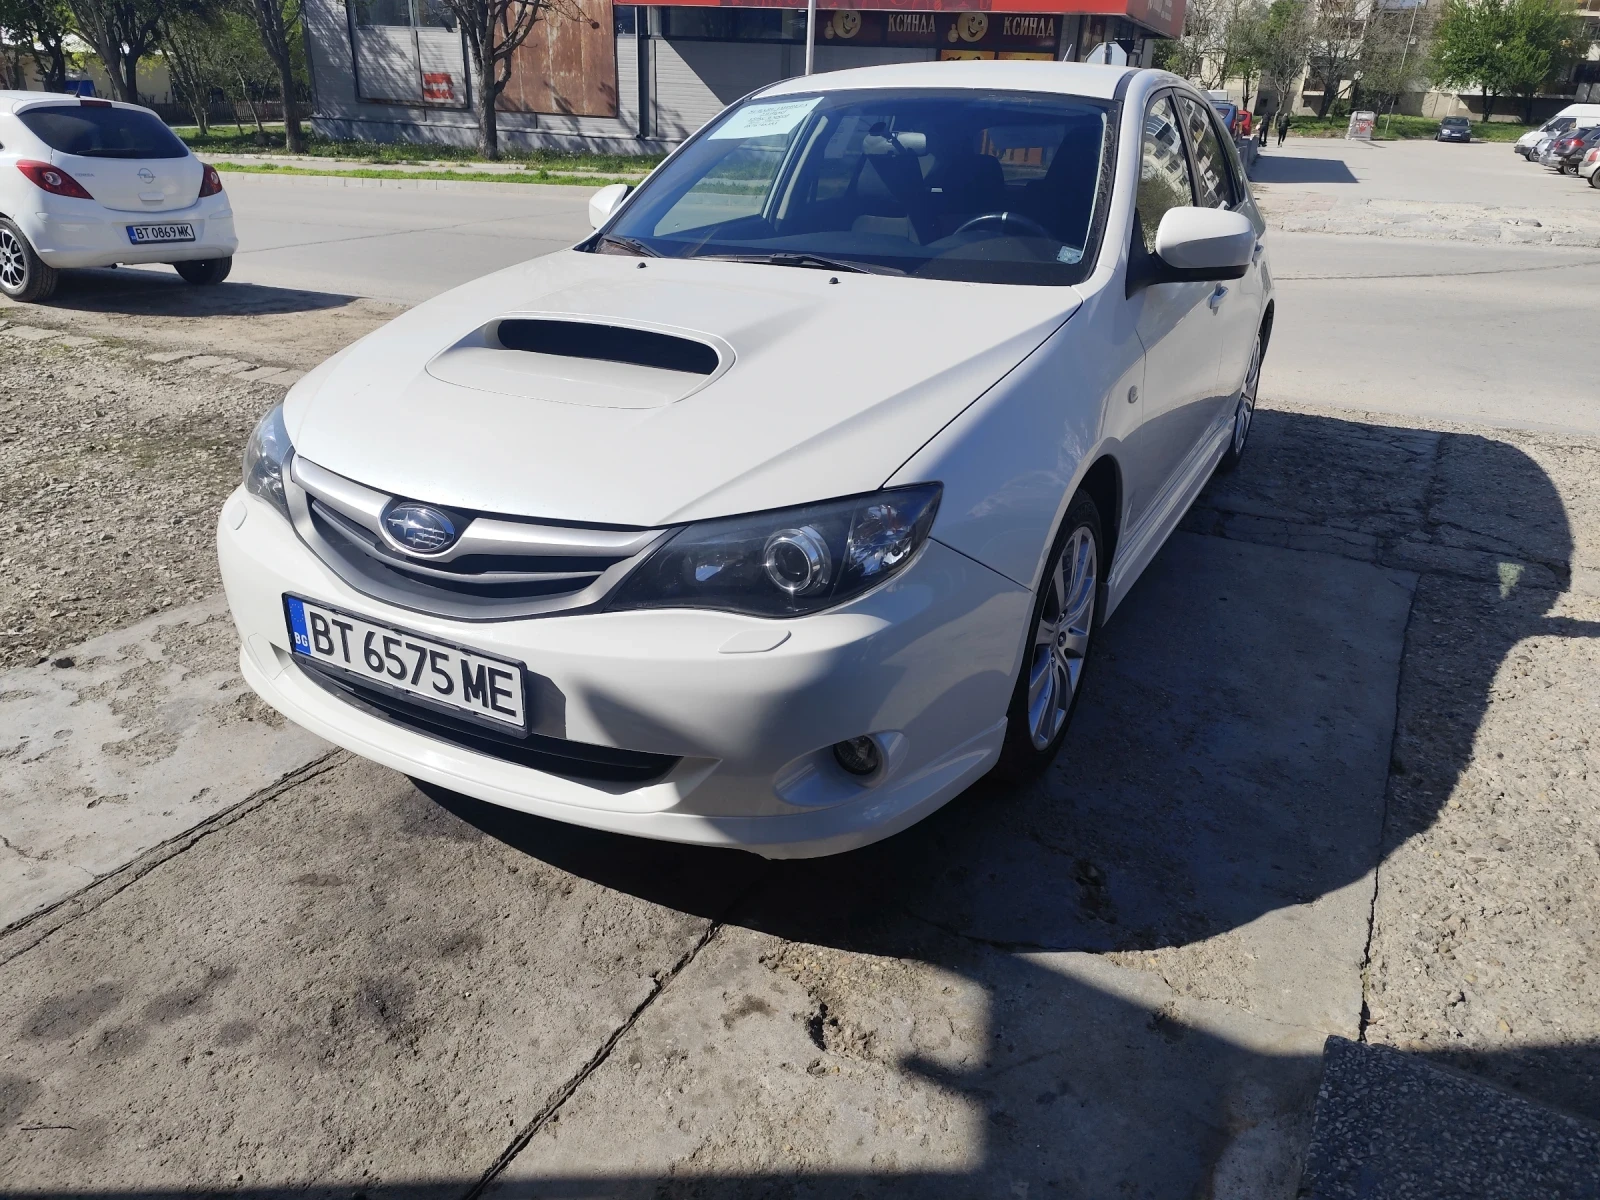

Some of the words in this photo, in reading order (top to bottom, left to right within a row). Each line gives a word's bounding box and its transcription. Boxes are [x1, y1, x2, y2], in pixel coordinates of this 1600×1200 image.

[888, 14, 935, 34] КСИНДА
[1003, 16, 1055, 38] КСИНДА
[135, 227, 150, 239] BT
[151, 226, 177, 238] 0869
[176, 225, 192, 237] MK
[294, 632, 309, 647] BG
[309, 611, 354, 664] BT
[363, 630, 455, 696] 6575
[460, 658, 517, 718] ME
